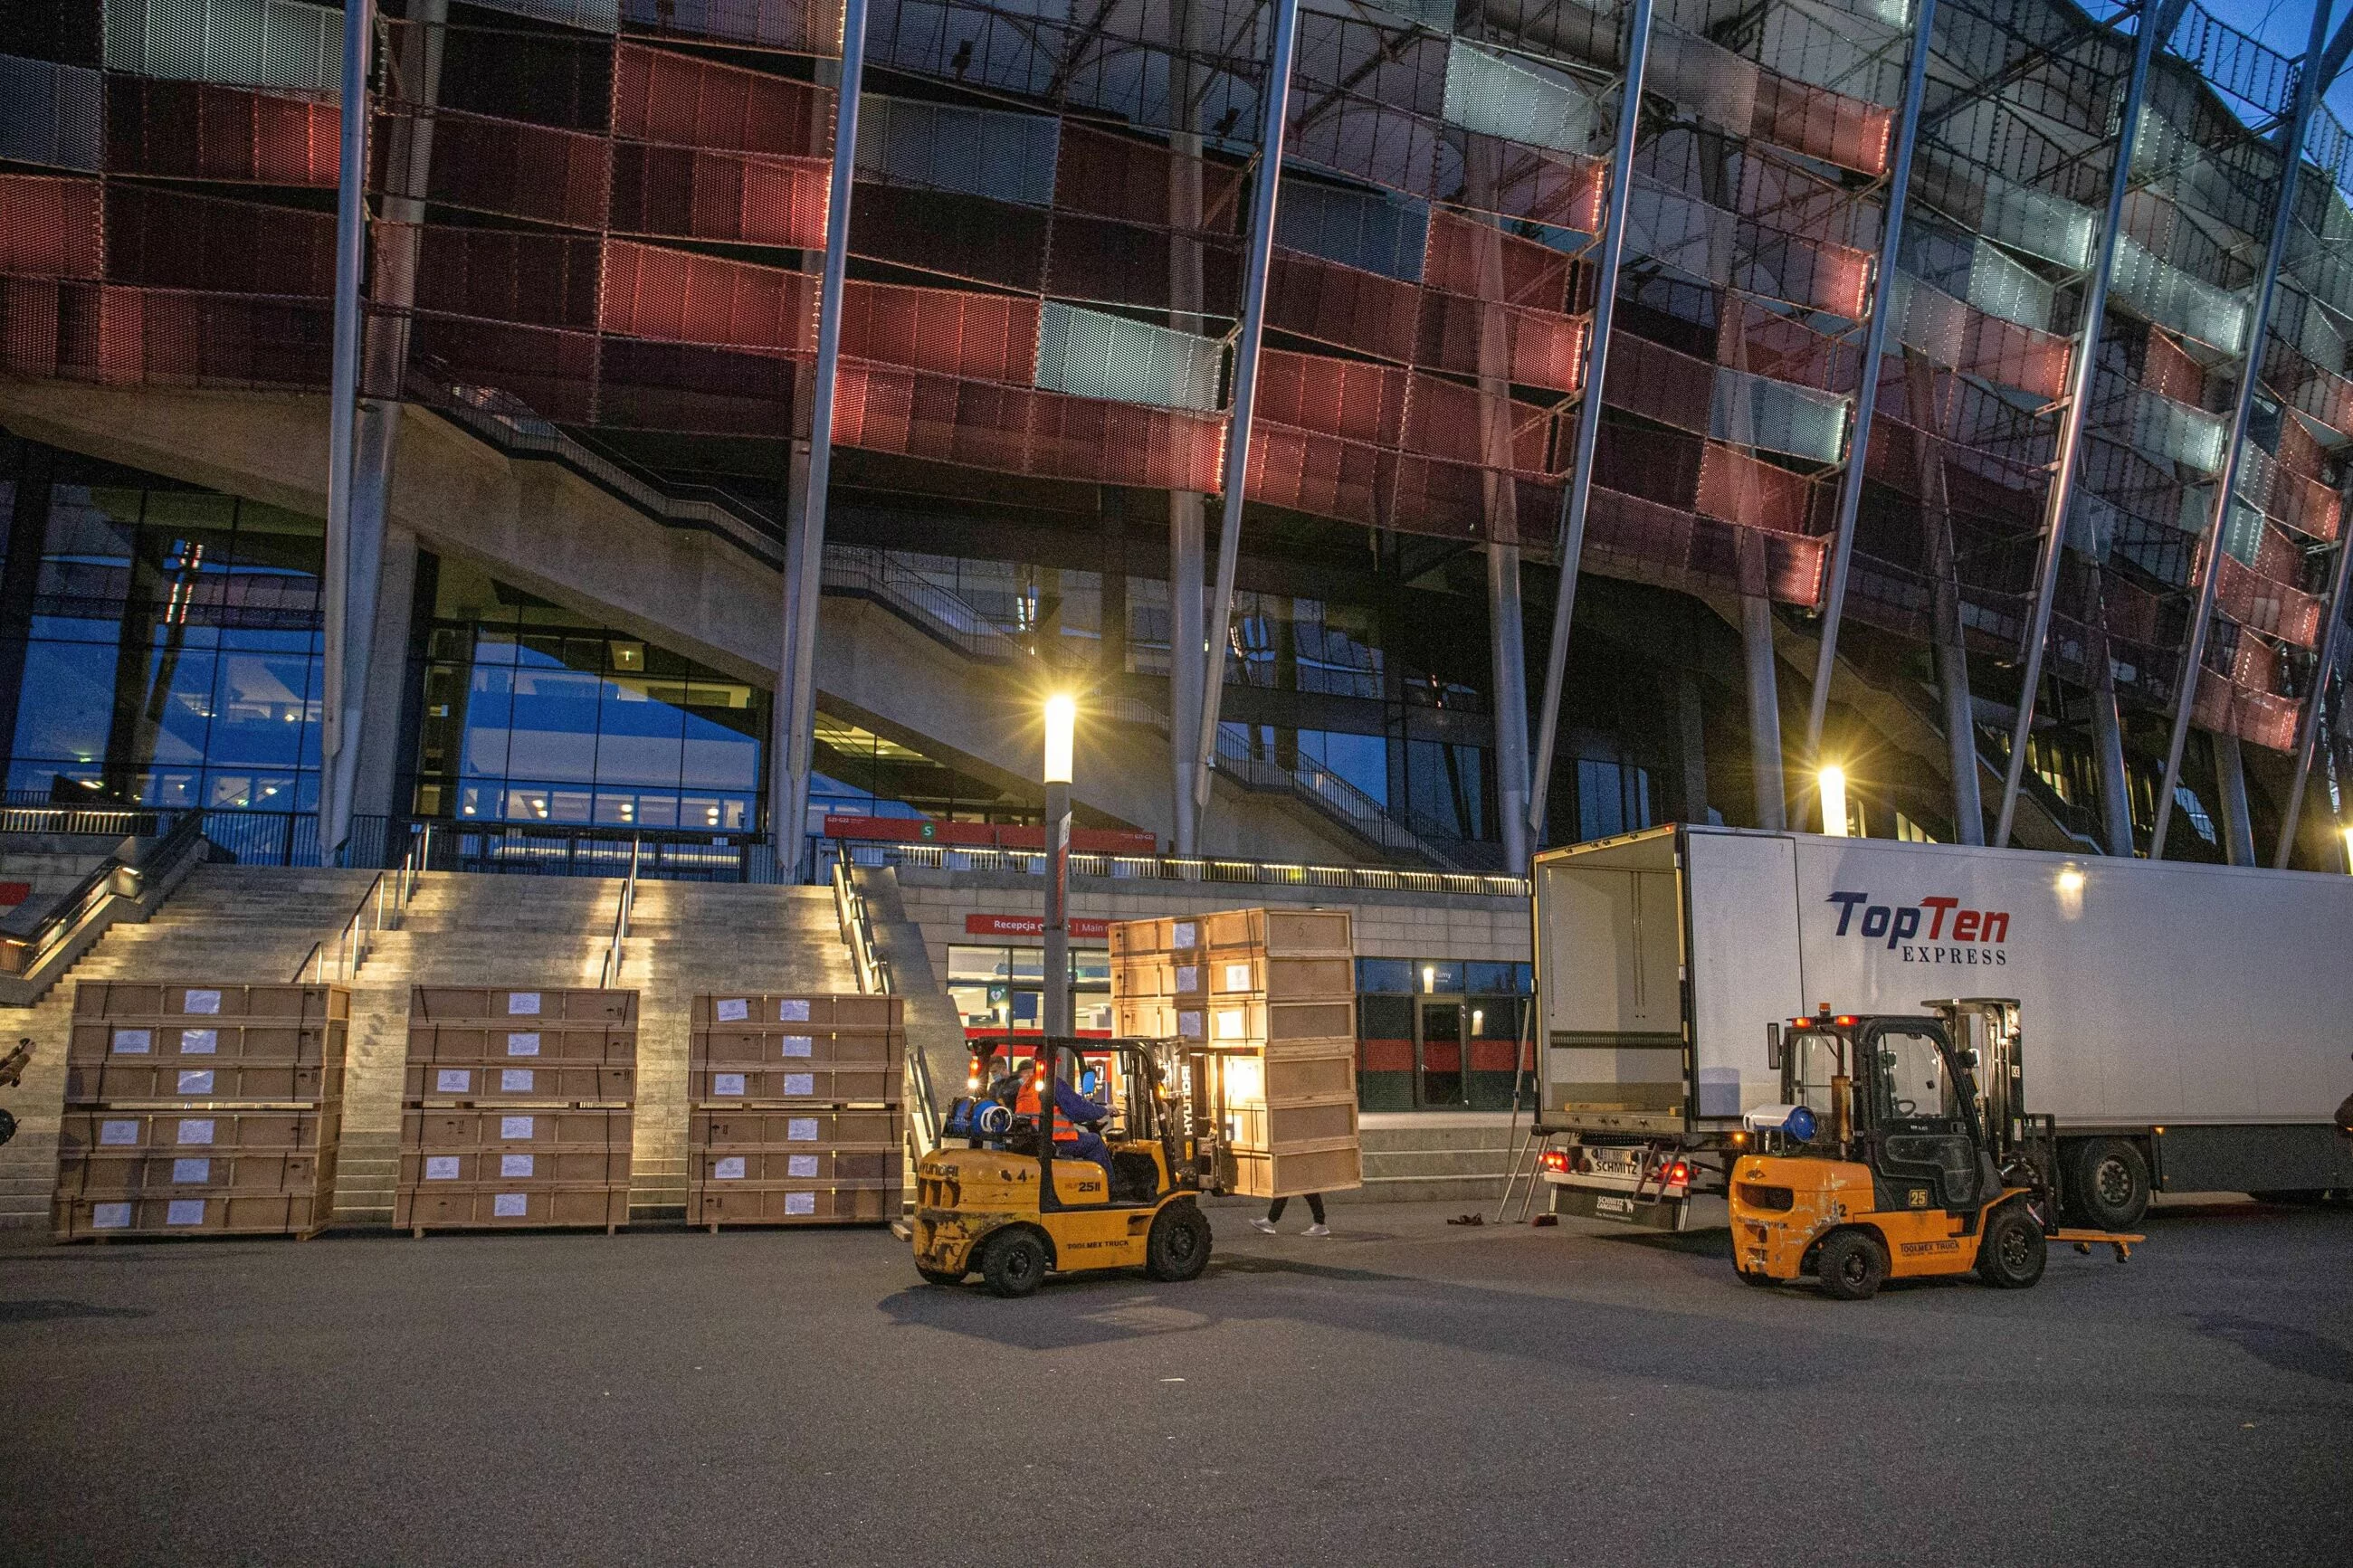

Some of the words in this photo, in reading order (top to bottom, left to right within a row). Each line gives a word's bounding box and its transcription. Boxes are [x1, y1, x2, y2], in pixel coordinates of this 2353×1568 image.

[924, 825, 932, 836] S
[994, 919, 1035, 932] Recepcja
[1081, 923, 1103, 932] Main
[1824, 891, 2010, 949] TopTen
[1903, 946, 2006, 965] EXPRESS
[1596, 1161, 1638, 1175] SCHMITZ
[1910, 1191, 1926, 1205] 25
[1900, 1241, 1934, 1253] TOOLMEX
[1936, 1240, 1960, 1250] TRUCK
